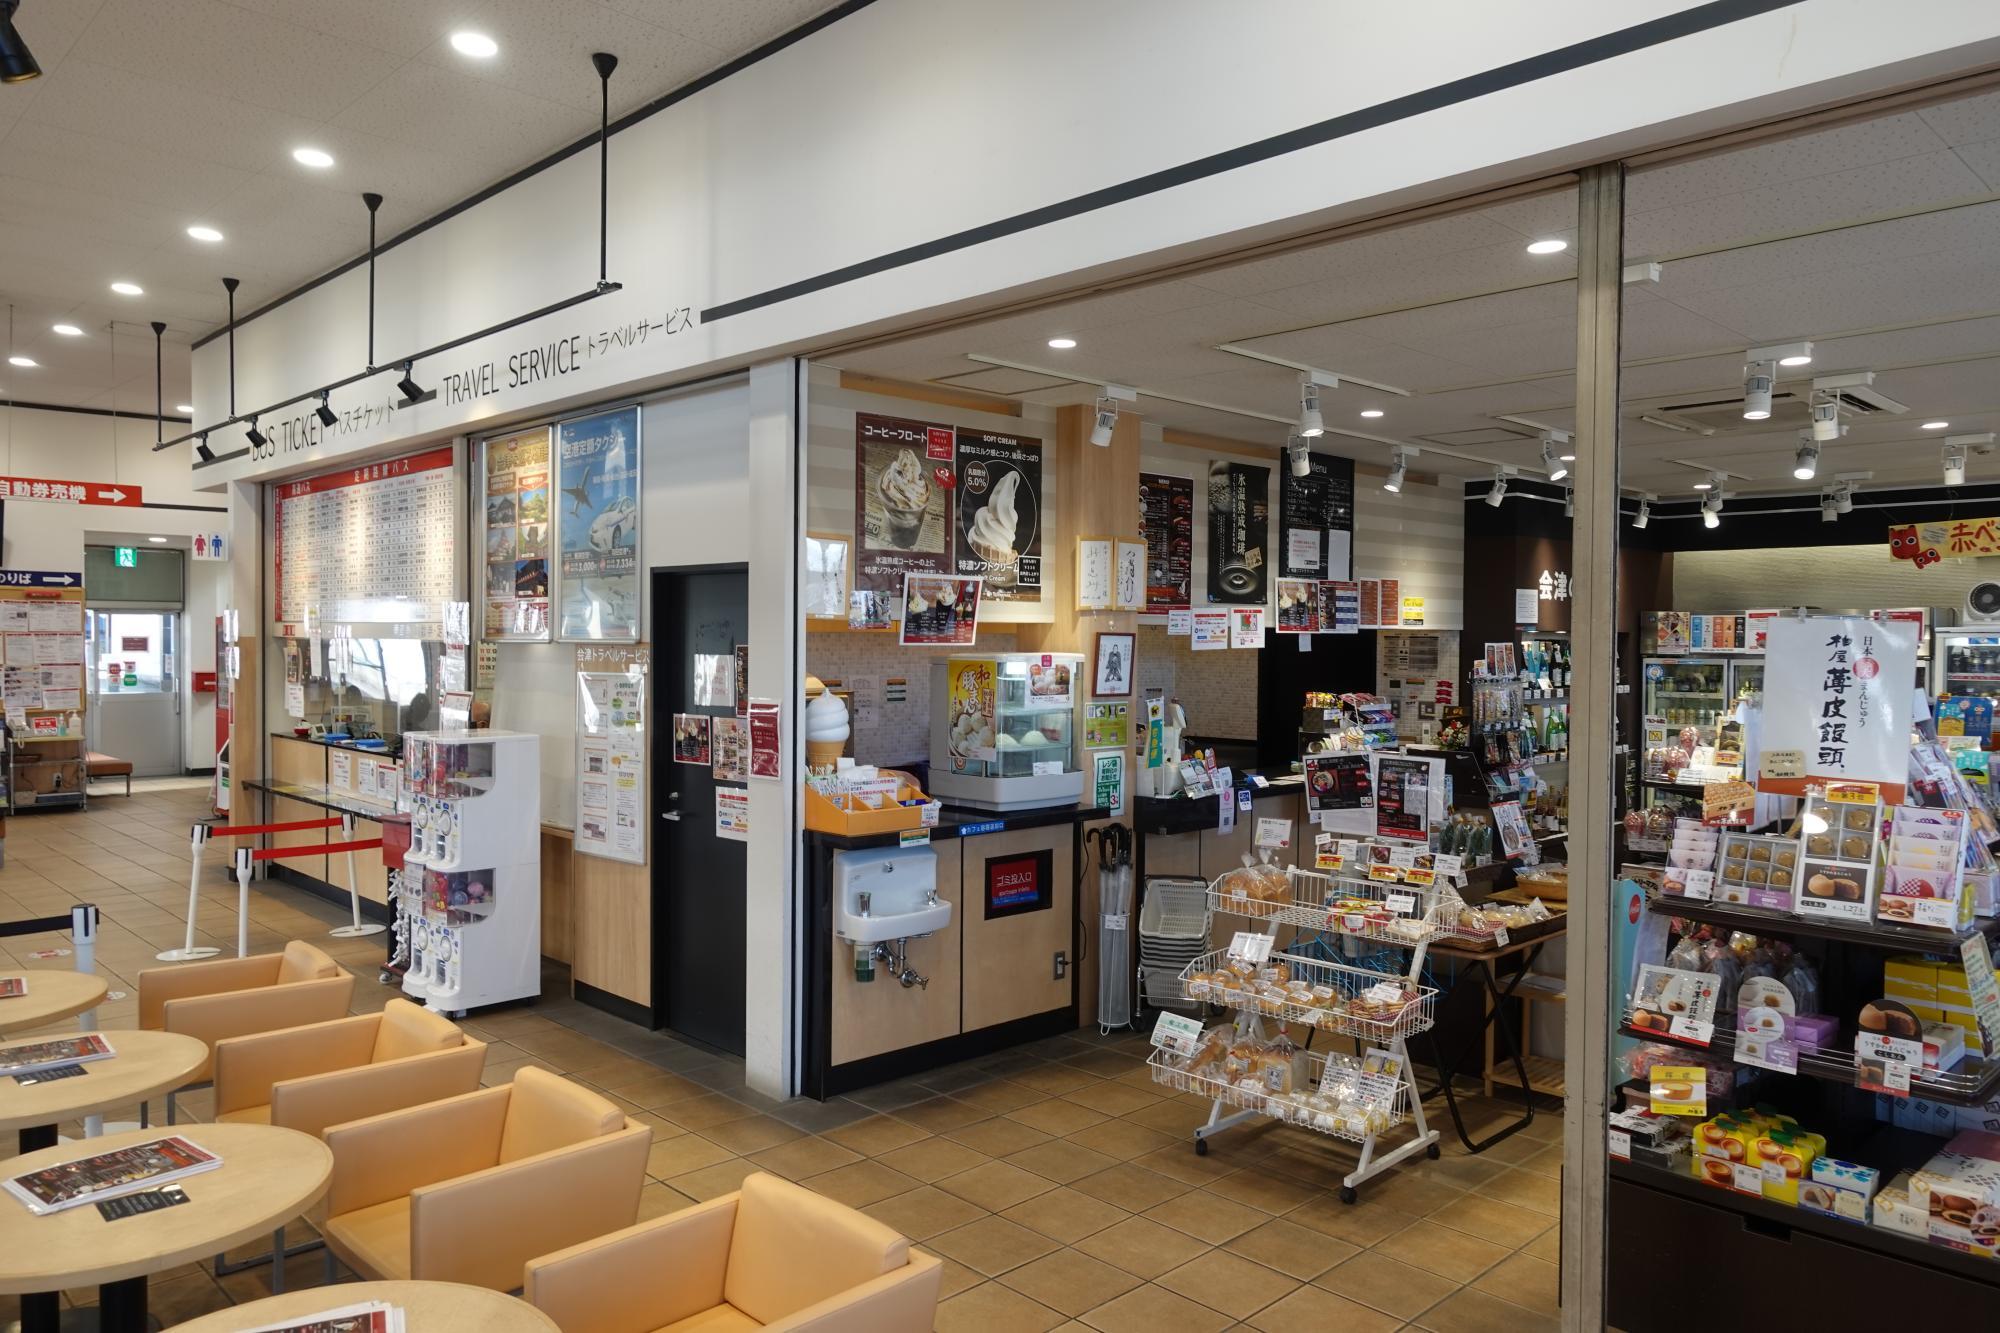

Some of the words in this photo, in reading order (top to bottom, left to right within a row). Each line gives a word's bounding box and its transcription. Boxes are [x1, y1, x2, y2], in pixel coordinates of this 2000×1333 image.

[588, 306, 694, 359] トラベルサービス
[443, 362, 500, 407] TRAVEL
[509, 335, 581, 389] SERVICE
[332, 396, 395, 437] バスチケット
[865, 425, 927, 442] コーヒーフロート
[983, 434, 997, 443] SOFT
[998, 436, 1017, 446] CREAM
[0, 480, 86, 501] 自動券売機
[968, 476, 987, 487] 5.0%
[1950, 519, 2000, 552] 赤べ
[958, 559, 1019, 572] 特濃ソフトクリーム
[576, 647, 650, 663] 会津トラベルサービス
[1858, 635, 1874, 728] 日本まんじゅう
[996, 871, 1033, 887] ゴミ投入口
